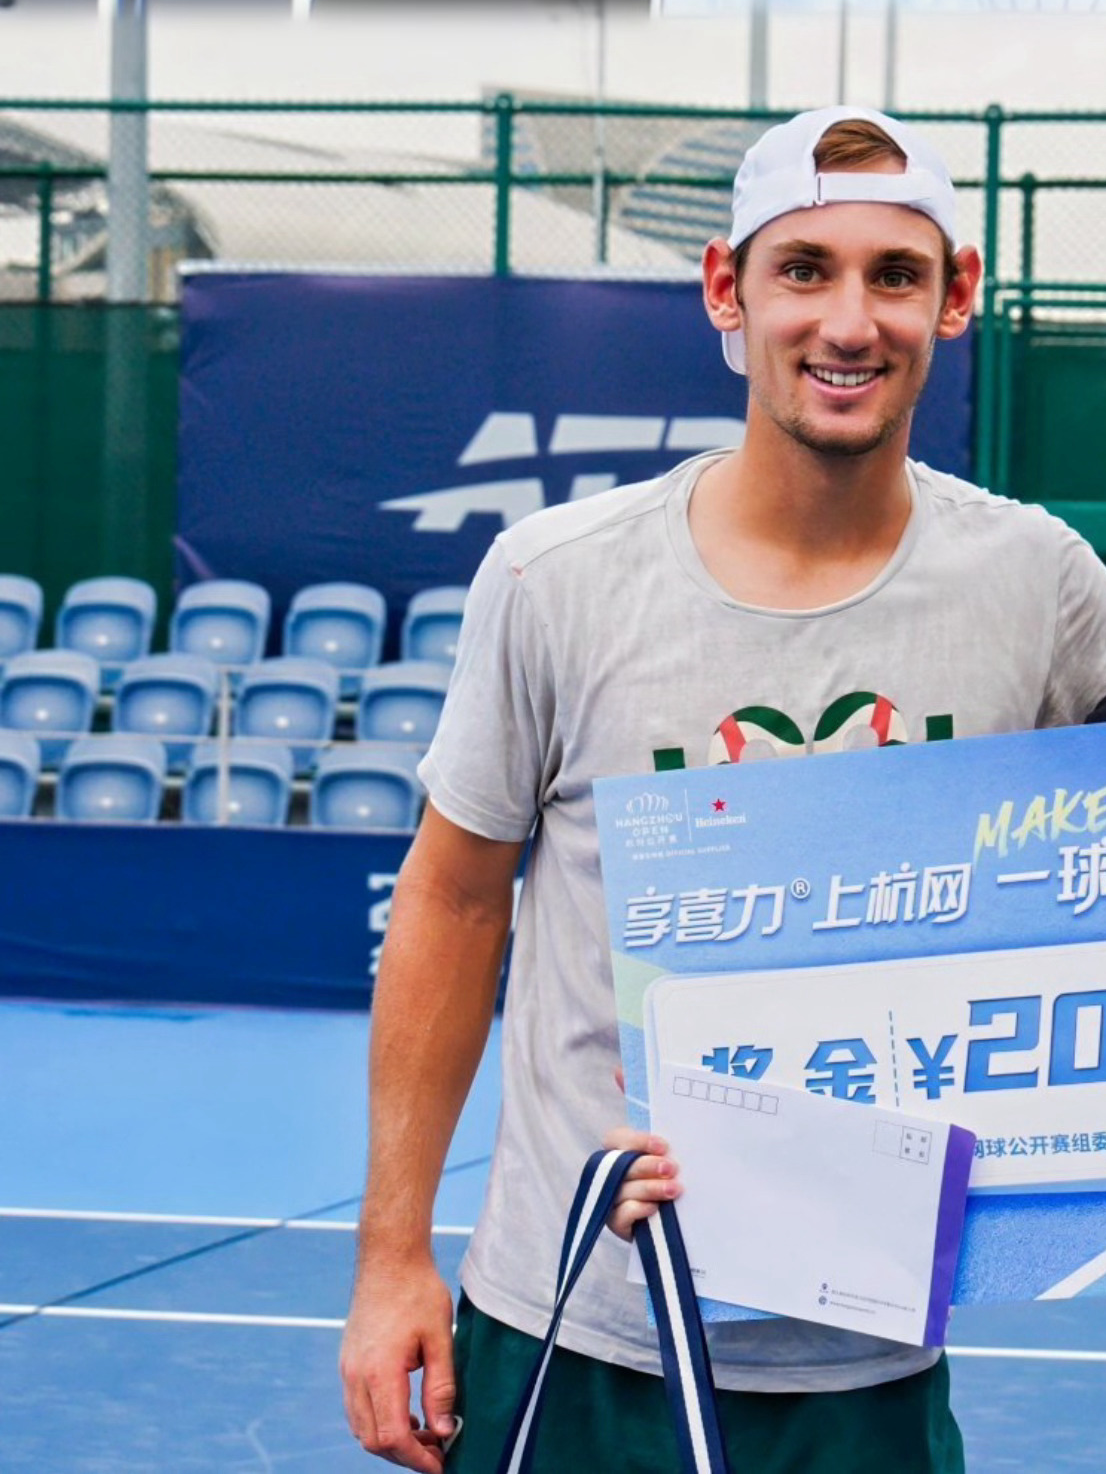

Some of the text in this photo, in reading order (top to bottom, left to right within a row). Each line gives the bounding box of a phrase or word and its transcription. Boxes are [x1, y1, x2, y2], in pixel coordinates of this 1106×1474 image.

[380, 412, 746, 532] AT
[615, 813, 683, 829] HANGZHOU
[632, 825, 669, 837] OPEN
[812, 862, 972, 933] 上杭网
